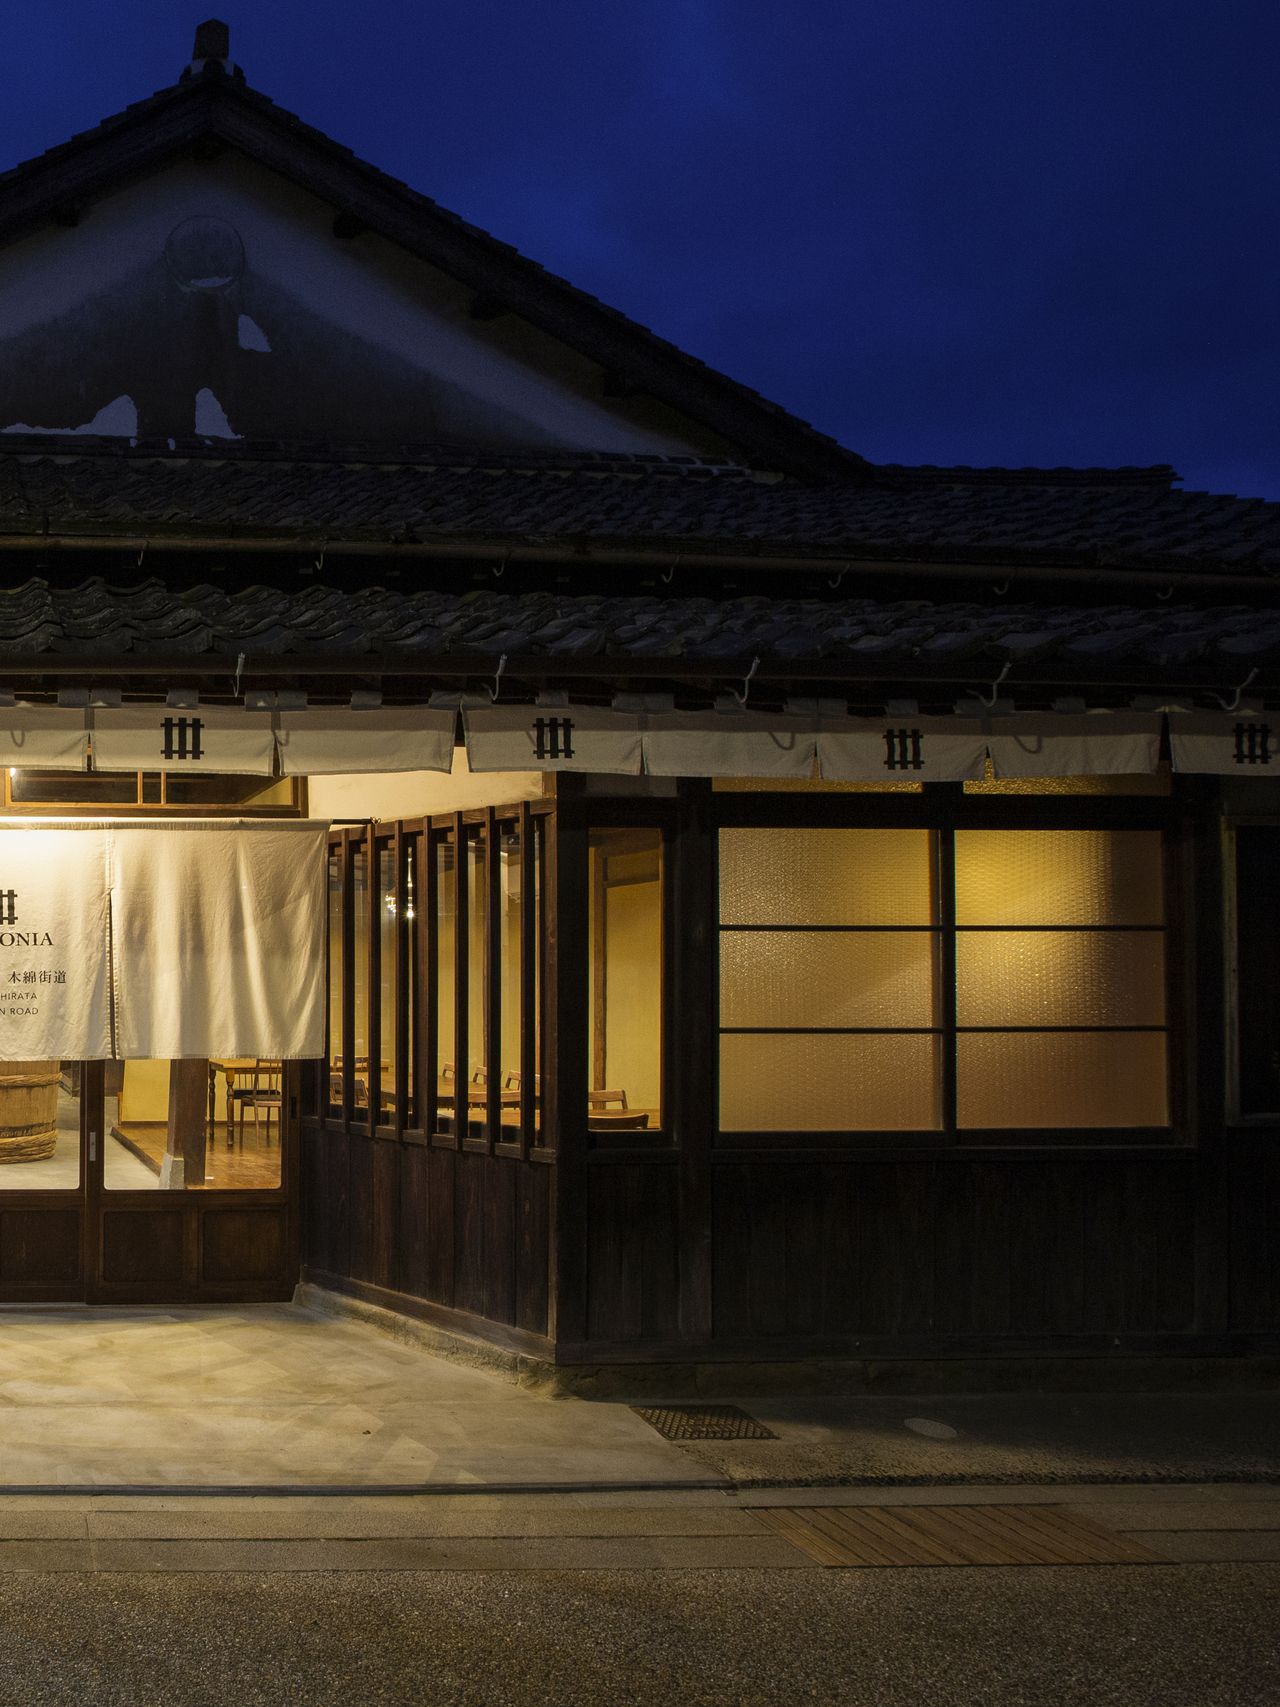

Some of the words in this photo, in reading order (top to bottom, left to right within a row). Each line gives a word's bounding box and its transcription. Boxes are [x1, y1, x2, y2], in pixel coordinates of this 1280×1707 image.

[7, 970, 67, 985] 木綿街道
[0, 992, 38, 1001] HIRATA
[10, 1007, 39, 1015] ROAD
